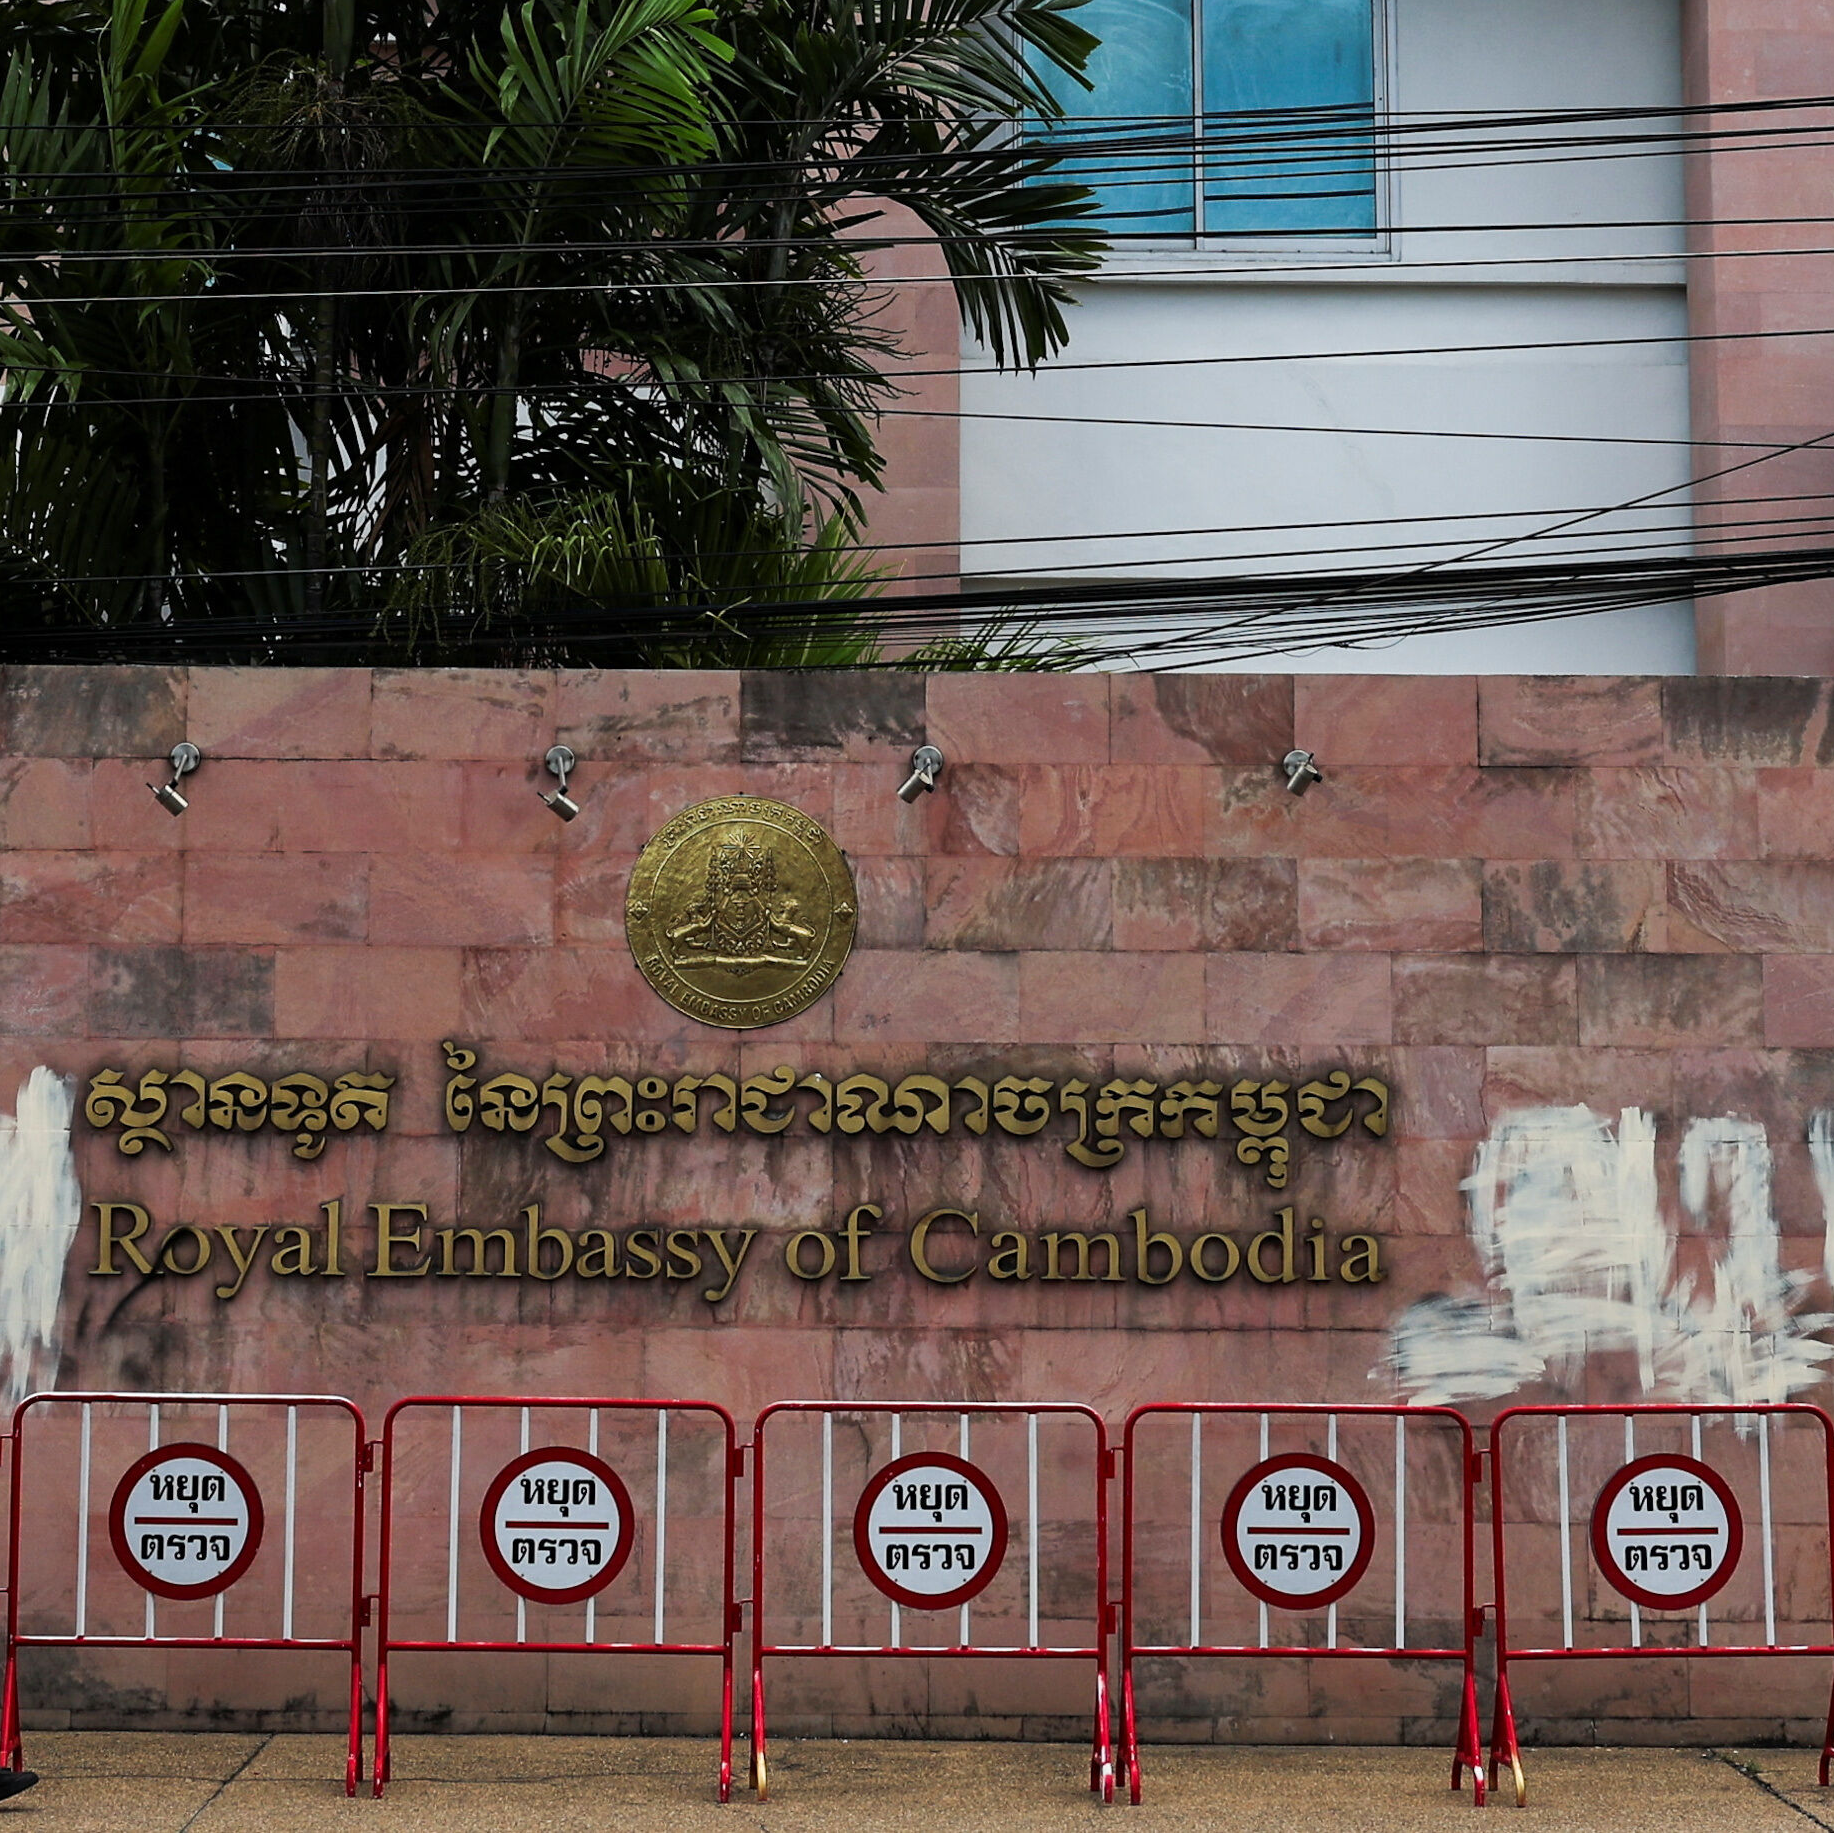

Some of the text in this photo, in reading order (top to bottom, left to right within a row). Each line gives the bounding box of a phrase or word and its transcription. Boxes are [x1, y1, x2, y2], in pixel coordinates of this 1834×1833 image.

[645, 954, 836, 1020] ROYAL EMBASSY OF CAMBODIA
[85, 1068, 396, 1159] ស្ថានទូត
[89, 1199, 1387, 1302] Royal Embassy of Cambodia
[150, 1475, 225, 1513] หยุด
[520, 1479, 595, 1517] หยุด
[893, 1484, 967, 1522] หยุด
[1262, 1485, 1336, 1523] หยุด
[1629, 1485, 1703, 1523] หยุด
[141, 1534, 230, 1561] ตรวจ
[512, 1538, 601, 1565] ตรวจ
[886, 1544, 974, 1569] ตรวจ
[1255, 1544, 1342, 1570] ตรวจ
[1625, 1544, 1712, 1570] ตรวจ
